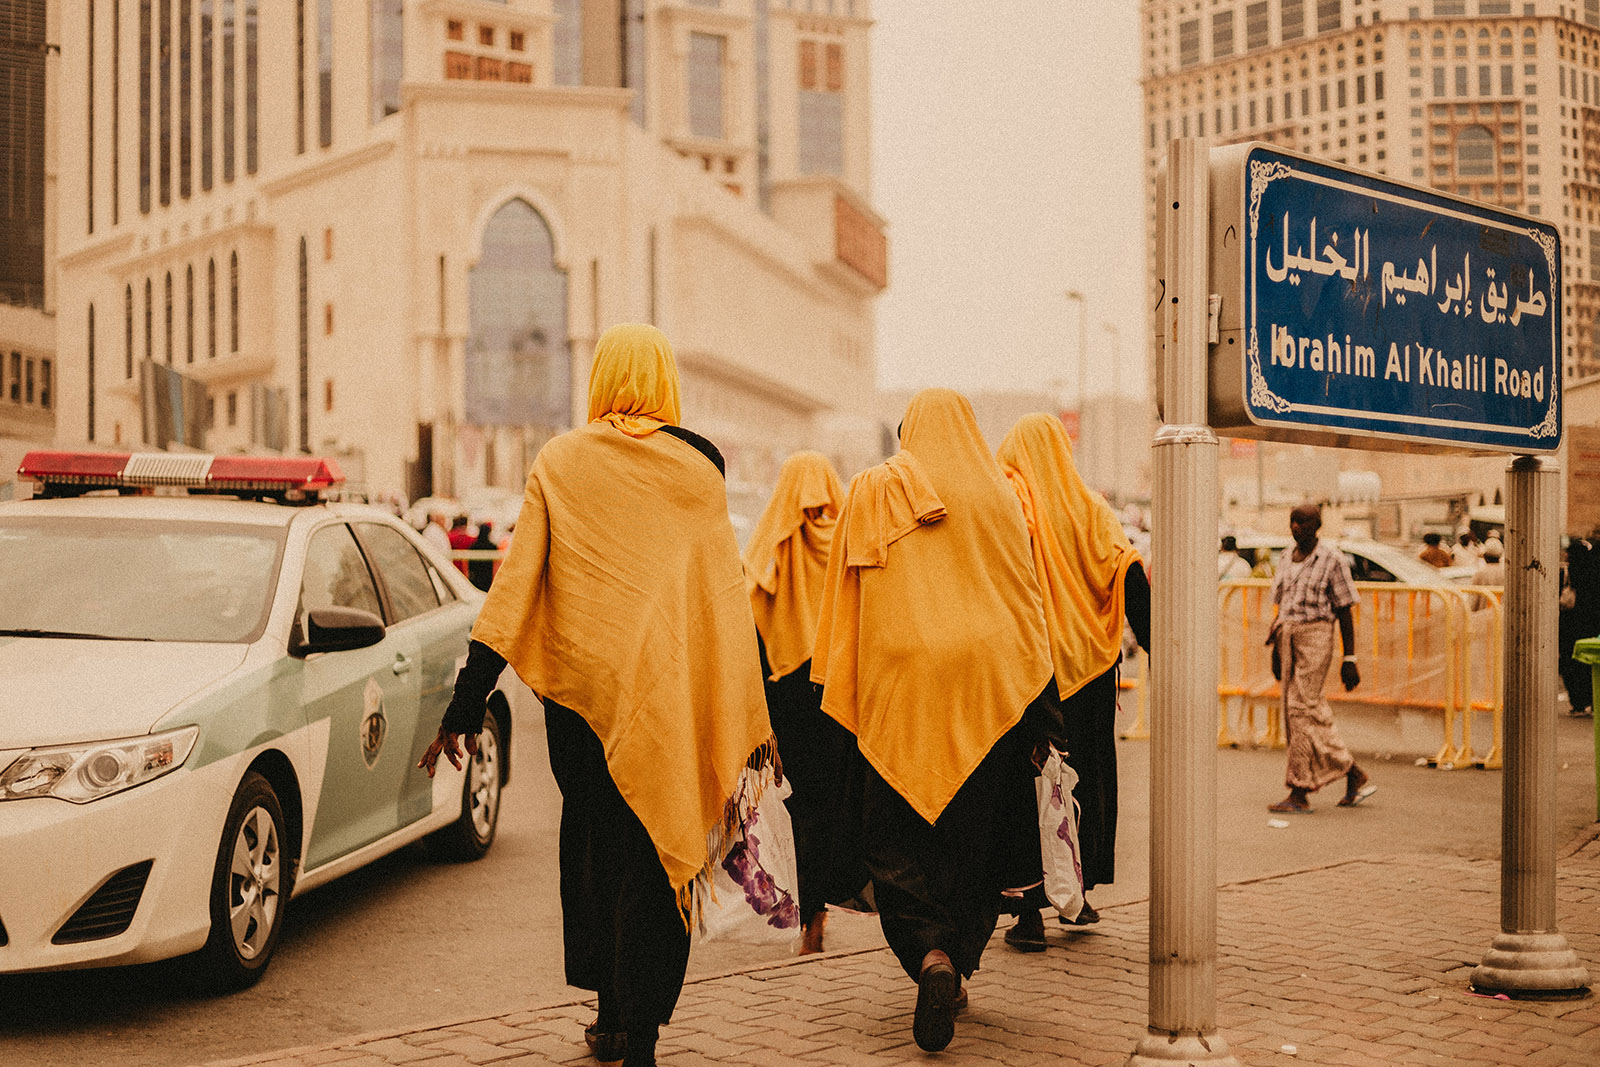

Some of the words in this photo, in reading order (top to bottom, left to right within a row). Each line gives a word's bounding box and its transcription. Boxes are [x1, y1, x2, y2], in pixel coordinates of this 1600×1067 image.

[1266, 210, 1370, 286] الخليل
[1381, 244, 1473, 318] إبراهيم
[1481, 267, 1547, 327] طريق
[1270, 323, 1376, 378] Ibrahim
[1384, 342, 1410, 382] Al
[1417, 343, 1487, 393] Khalil
[1494, 357, 1544, 402] Road
